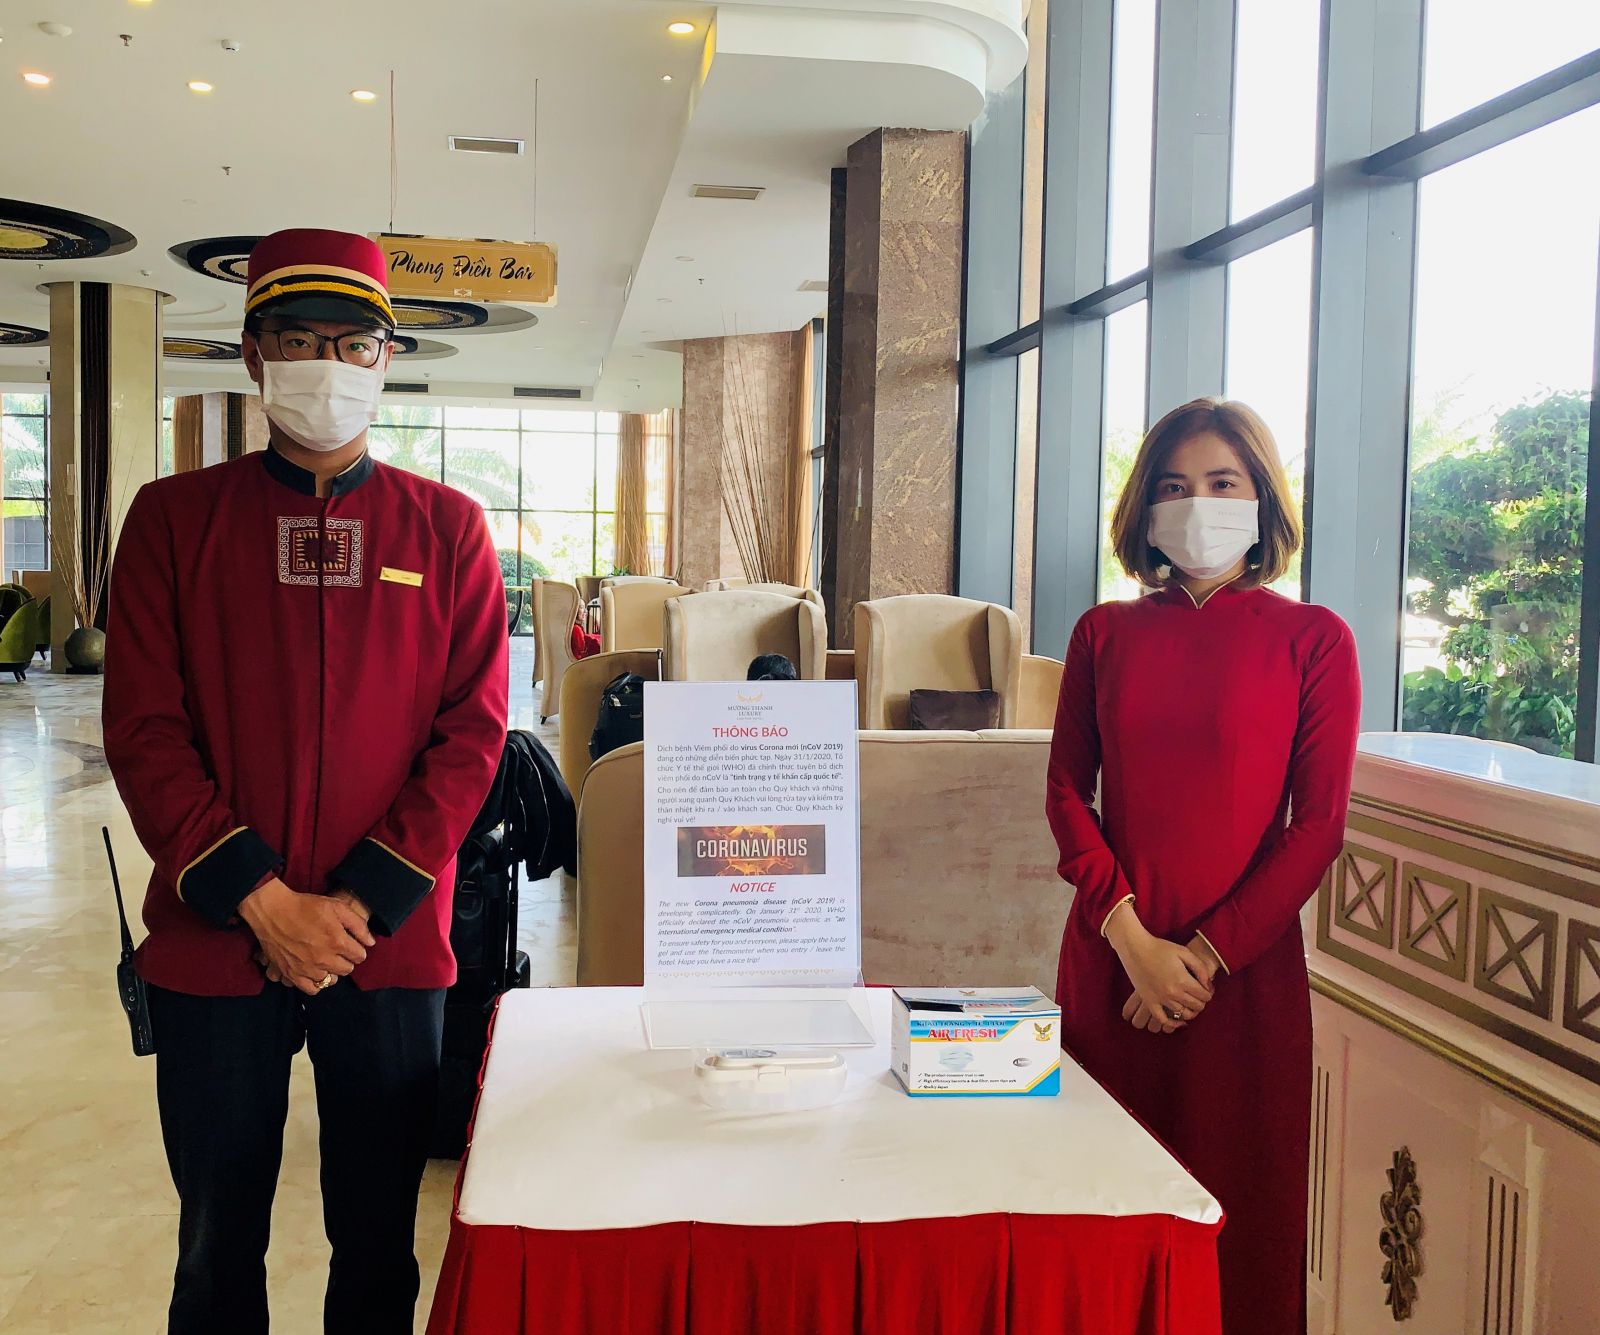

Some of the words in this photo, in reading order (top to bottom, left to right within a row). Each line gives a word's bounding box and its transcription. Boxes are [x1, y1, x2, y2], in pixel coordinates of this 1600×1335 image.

[390, 250, 444, 283] Phong
[453, 255, 493, 278] Điền
[499, 257, 535, 280] Bar
[712, 725, 758, 737] THÔNG
[762, 725, 788, 737] BÁO
[800, 743, 822, 752] (nCoV
[823, 743, 843, 752] 2019)
[721, 763, 746, 772] (WHO)
[695, 795, 717, 804] quanh
[795, 794, 807, 803] tay
[673, 815, 685, 823] vui
[696, 838, 808, 858] CORONAVIRUS
[730, 882, 776, 893] NOTICE
[694, 899, 719, 907] Corona
[722, 898, 759, 908] pneumonia
[791, 897, 812, 906] (nCoV
[815, 897, 835, 906] 2019)
[657, 909, 694, 918] developing
[759, 907, 785, 916] January
[657, 918, 686, 927] officially
[719, 917, 731, 925] the
[753, 916, 789, 926] pneumonia
[792, 916, 821, 925] epidemic
[657, 927, 699, 935] international
[736, 926, 762, 934] medical
[659, 939, 667, 947] To
[690, 938, 711, 947] safety
[710, 938, 722, 946] for
[778, 936, 800, 946] please
[799, 936, 818, 945] apply
[829, 935, 846, 943] hand
[657, 949, 669, 958] gel
[711, 947, 755, 955] Thermometer
[756, 946, 775, 954] when
[790, 946, 807, 955] entry
[815, 945, 832, 953] leave
[677, 958, 695, 967] Hope
[695, 959, 709, 967] you
[710, 957, 726, 965] have
[746, 956, 760, 966] trip!
[928, 1029, 952, 1041] AIR
[955, 1029, 997, 1041] FRESH
